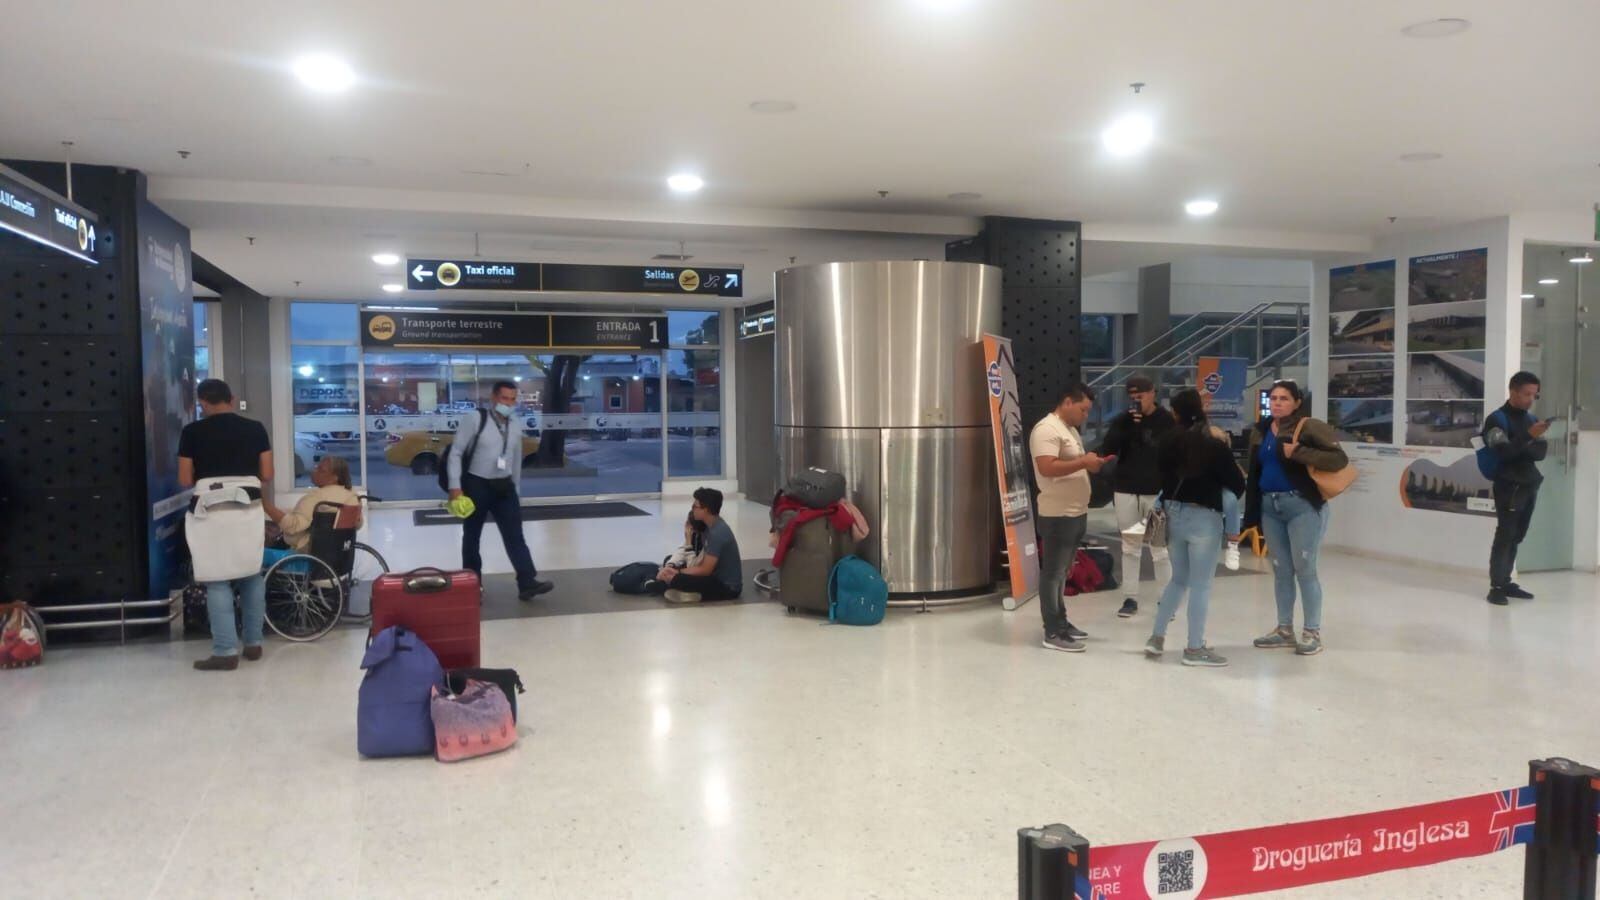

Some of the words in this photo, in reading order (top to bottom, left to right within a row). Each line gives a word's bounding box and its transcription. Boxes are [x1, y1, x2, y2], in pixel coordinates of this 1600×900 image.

[465, 265, 485, 275] Taxi
[486, 265, 515, 276] oficial
[644, 270, 675, 280] Salidas
[401, 317, 457, 329] Transporte
[459, 320, 503, 329] terrestre
[402, 330, 430, 338] Ground
[596, 321, 641, 331] ENTRADA
[649, 321, 660, 343] 1
[1252, 833, 1362, 872] Droguería
[1372, 820, 1470, 853] Inglesa
[1113, 865, 1122, 878] Y
